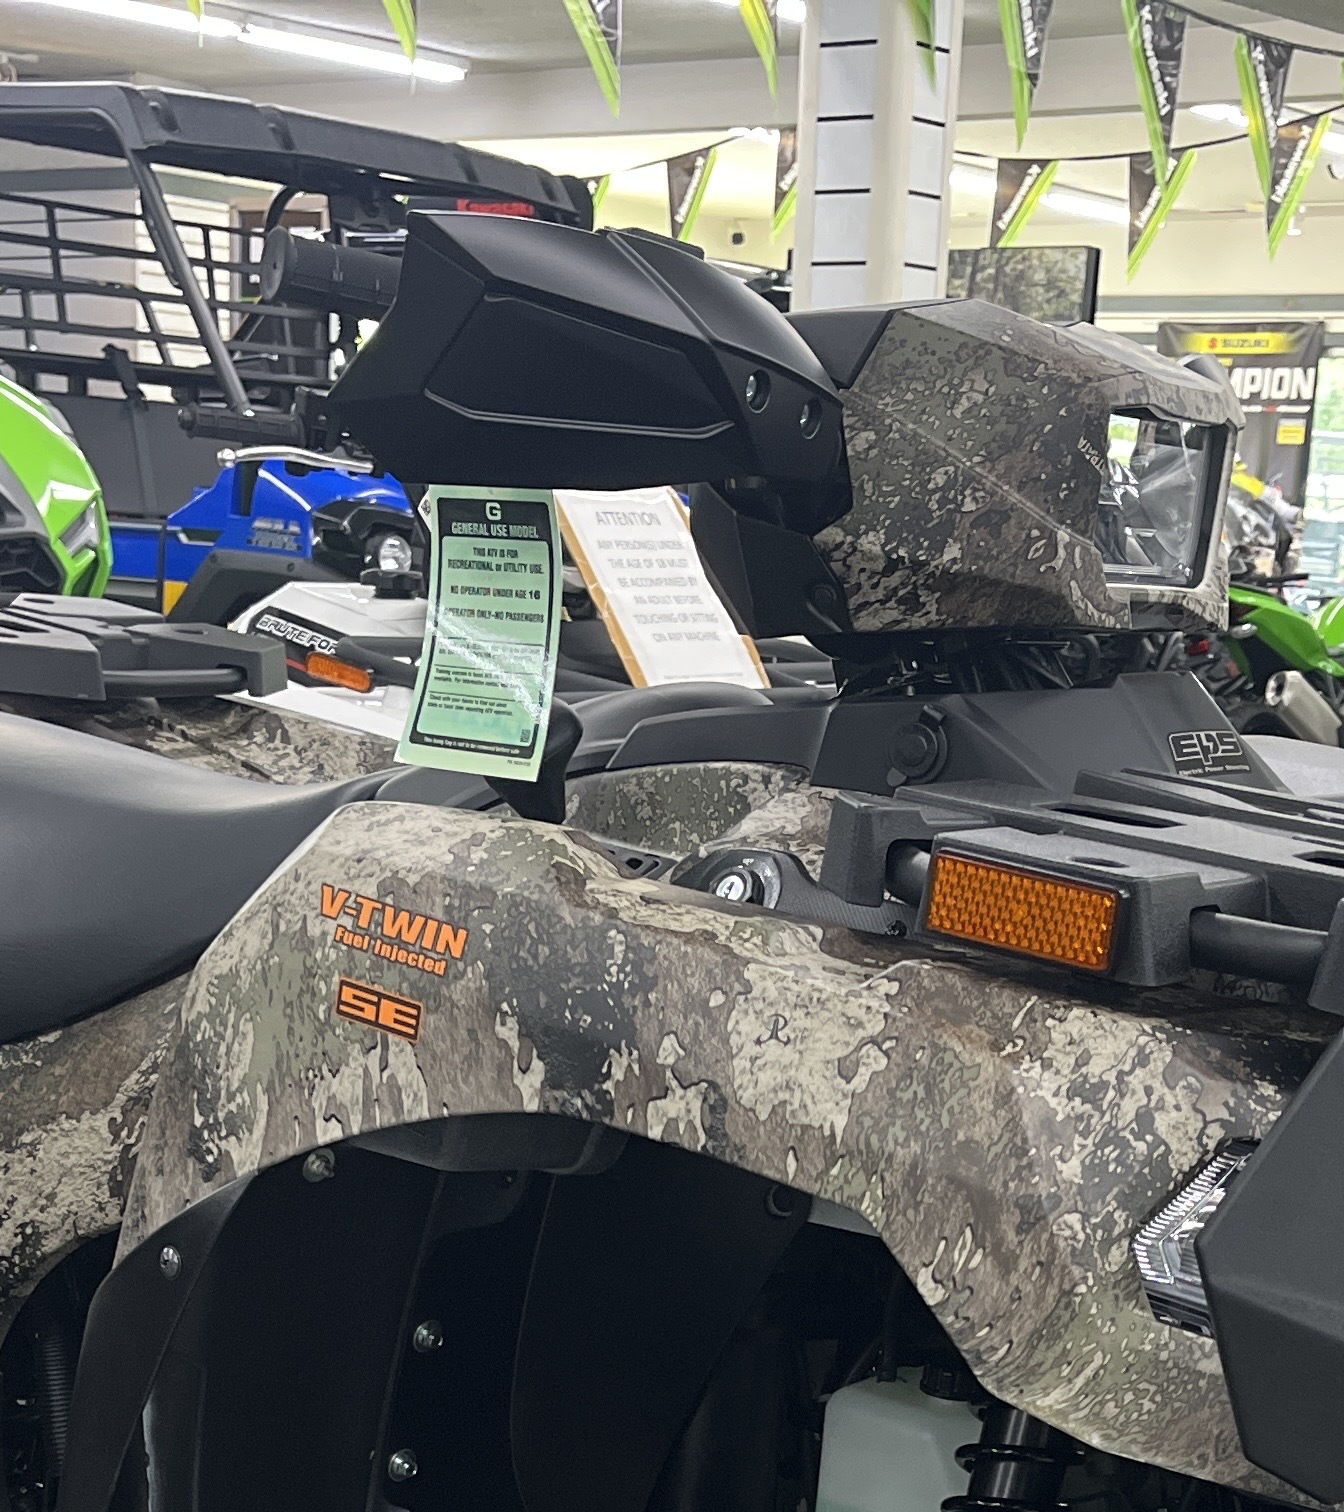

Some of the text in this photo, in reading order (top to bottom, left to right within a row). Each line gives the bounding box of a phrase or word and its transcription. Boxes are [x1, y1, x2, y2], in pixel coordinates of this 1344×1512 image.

[485, 501, 502, 521] G
[595, 511, 661, 526] ATTENTION
[451, 521, 490, 537] GENERAL
[490, 523, 509, 538] USE
[528, 589, 542, 600] 16
[258, 614, 309, 648] BRUTE
[320, 882, 469, 961] V-TWIN
[333, 924, 449, 977] Fuel Injected
[338, 984, 421, 1035] SE
